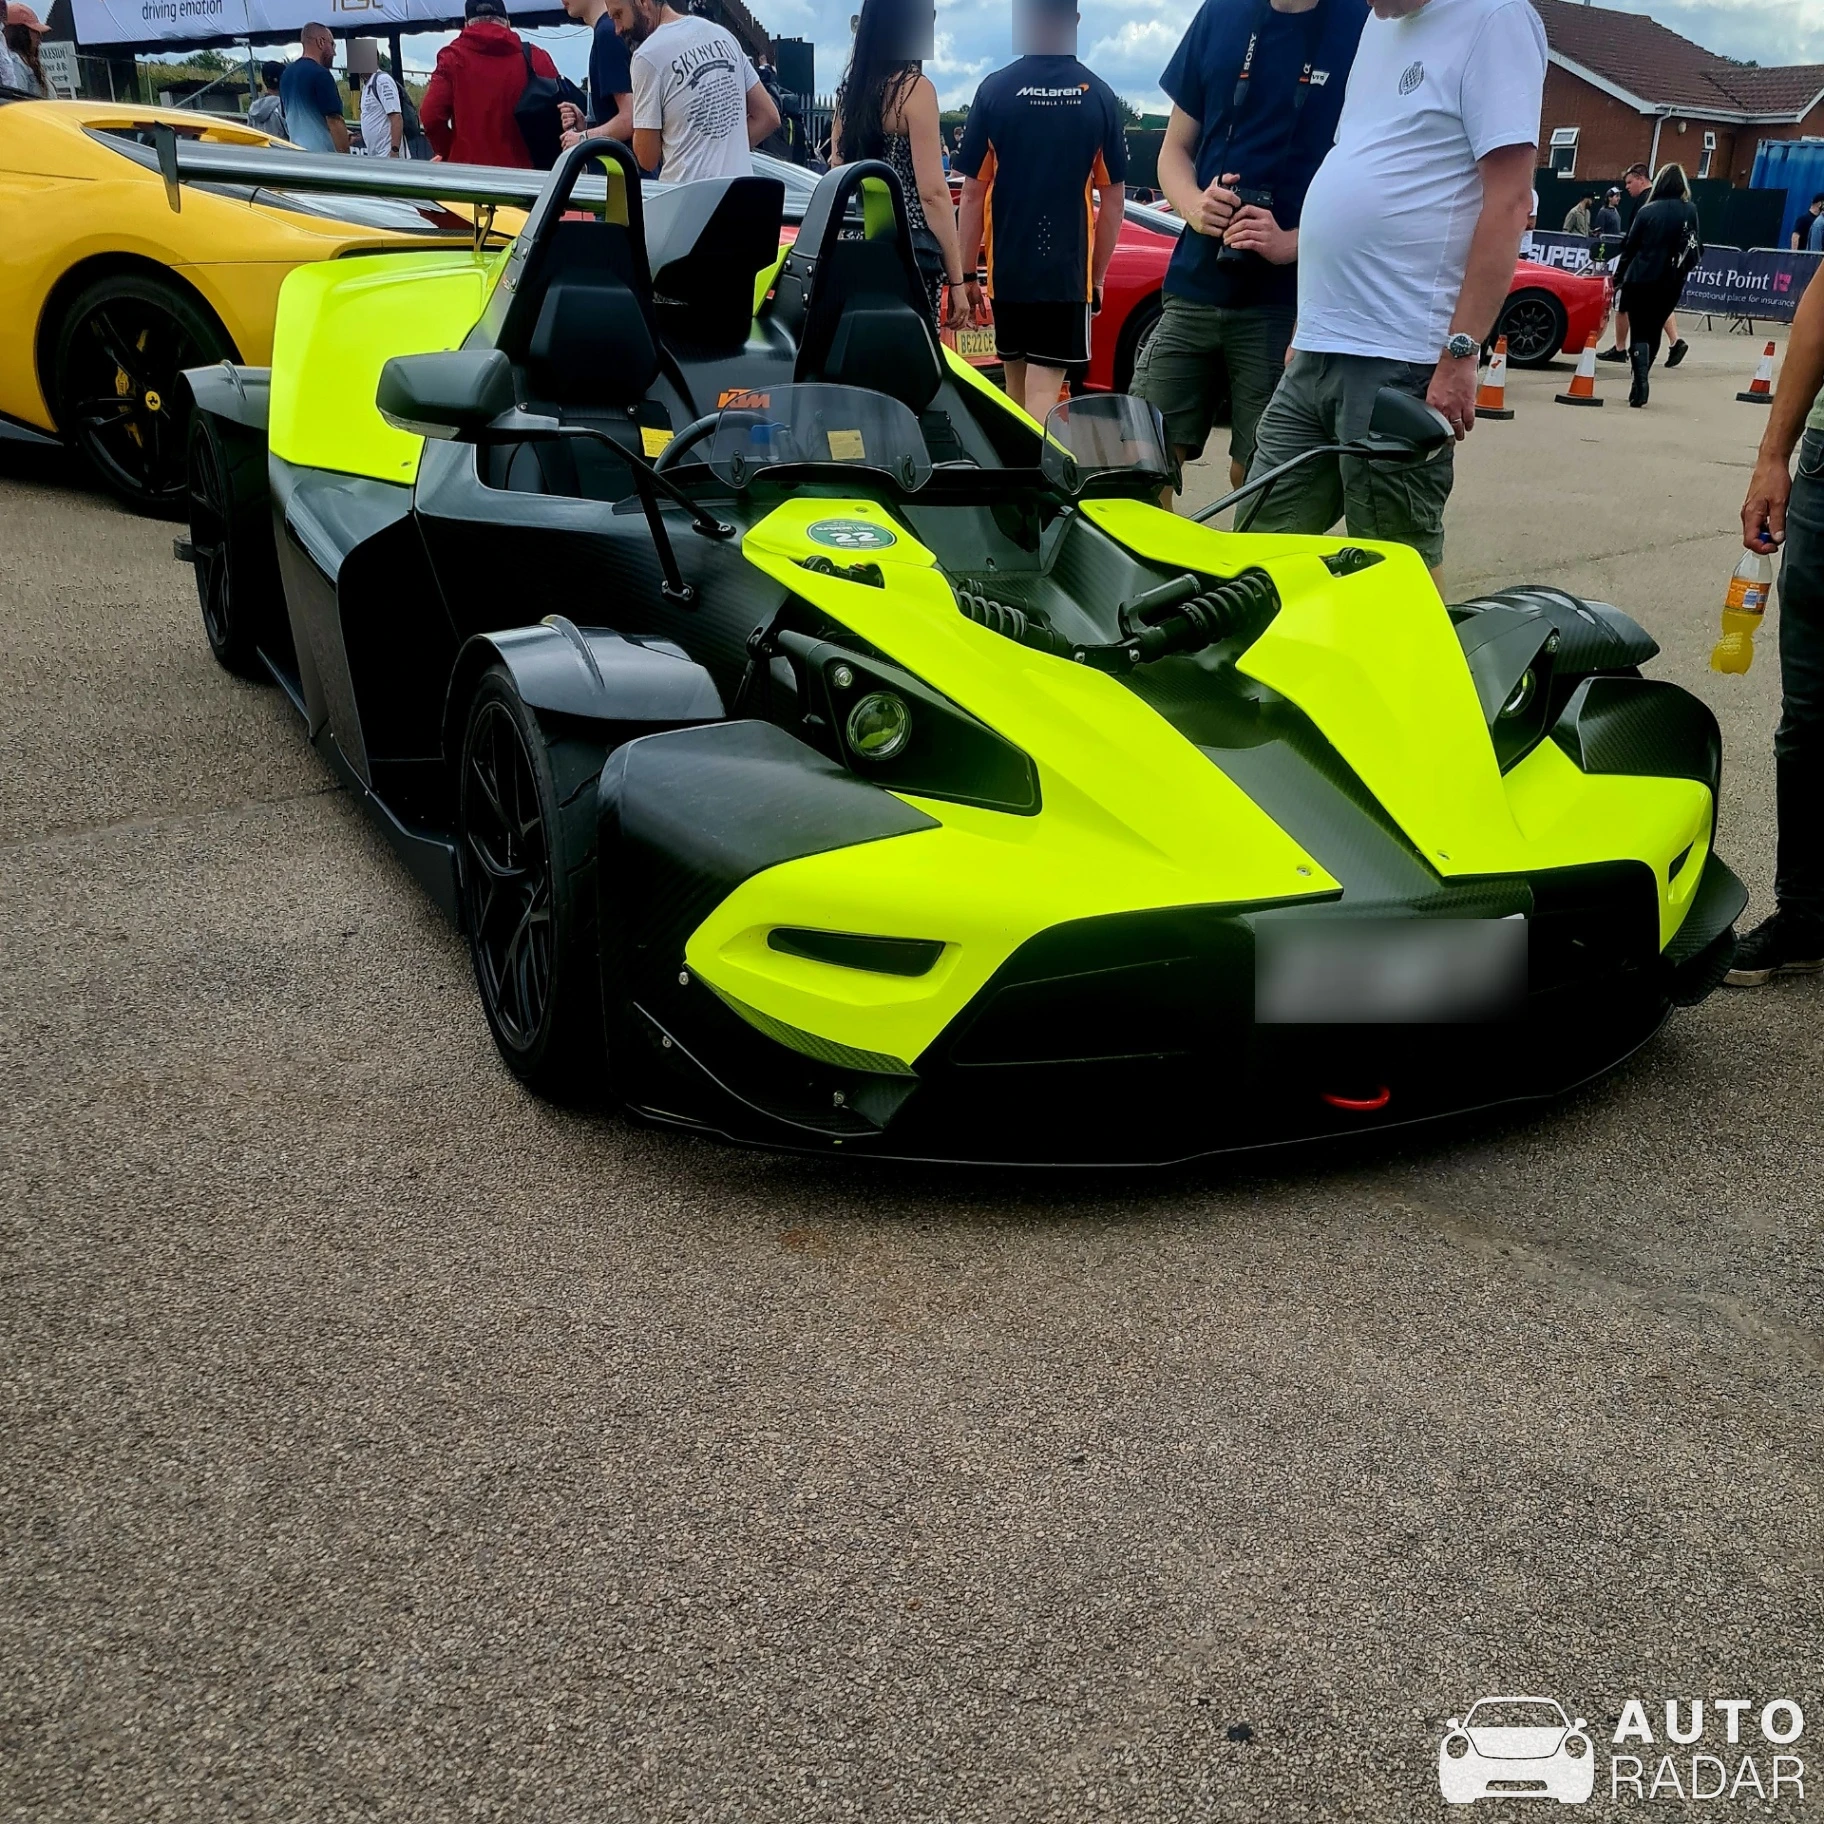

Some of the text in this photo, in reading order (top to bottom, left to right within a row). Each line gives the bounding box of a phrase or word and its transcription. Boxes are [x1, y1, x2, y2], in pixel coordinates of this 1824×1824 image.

[142, 0, 223, 22] driving emotion
[1243, 32, 1257, 70] SONY
[1016, 86, 1082, 97] McLaren
[1725, 269, 1770, 290] Point
[1686, 290, 1795, 308] exceptional place for insurance
[717, 388, 771, 409] KTM
[829, 531, 881, 543] 22
